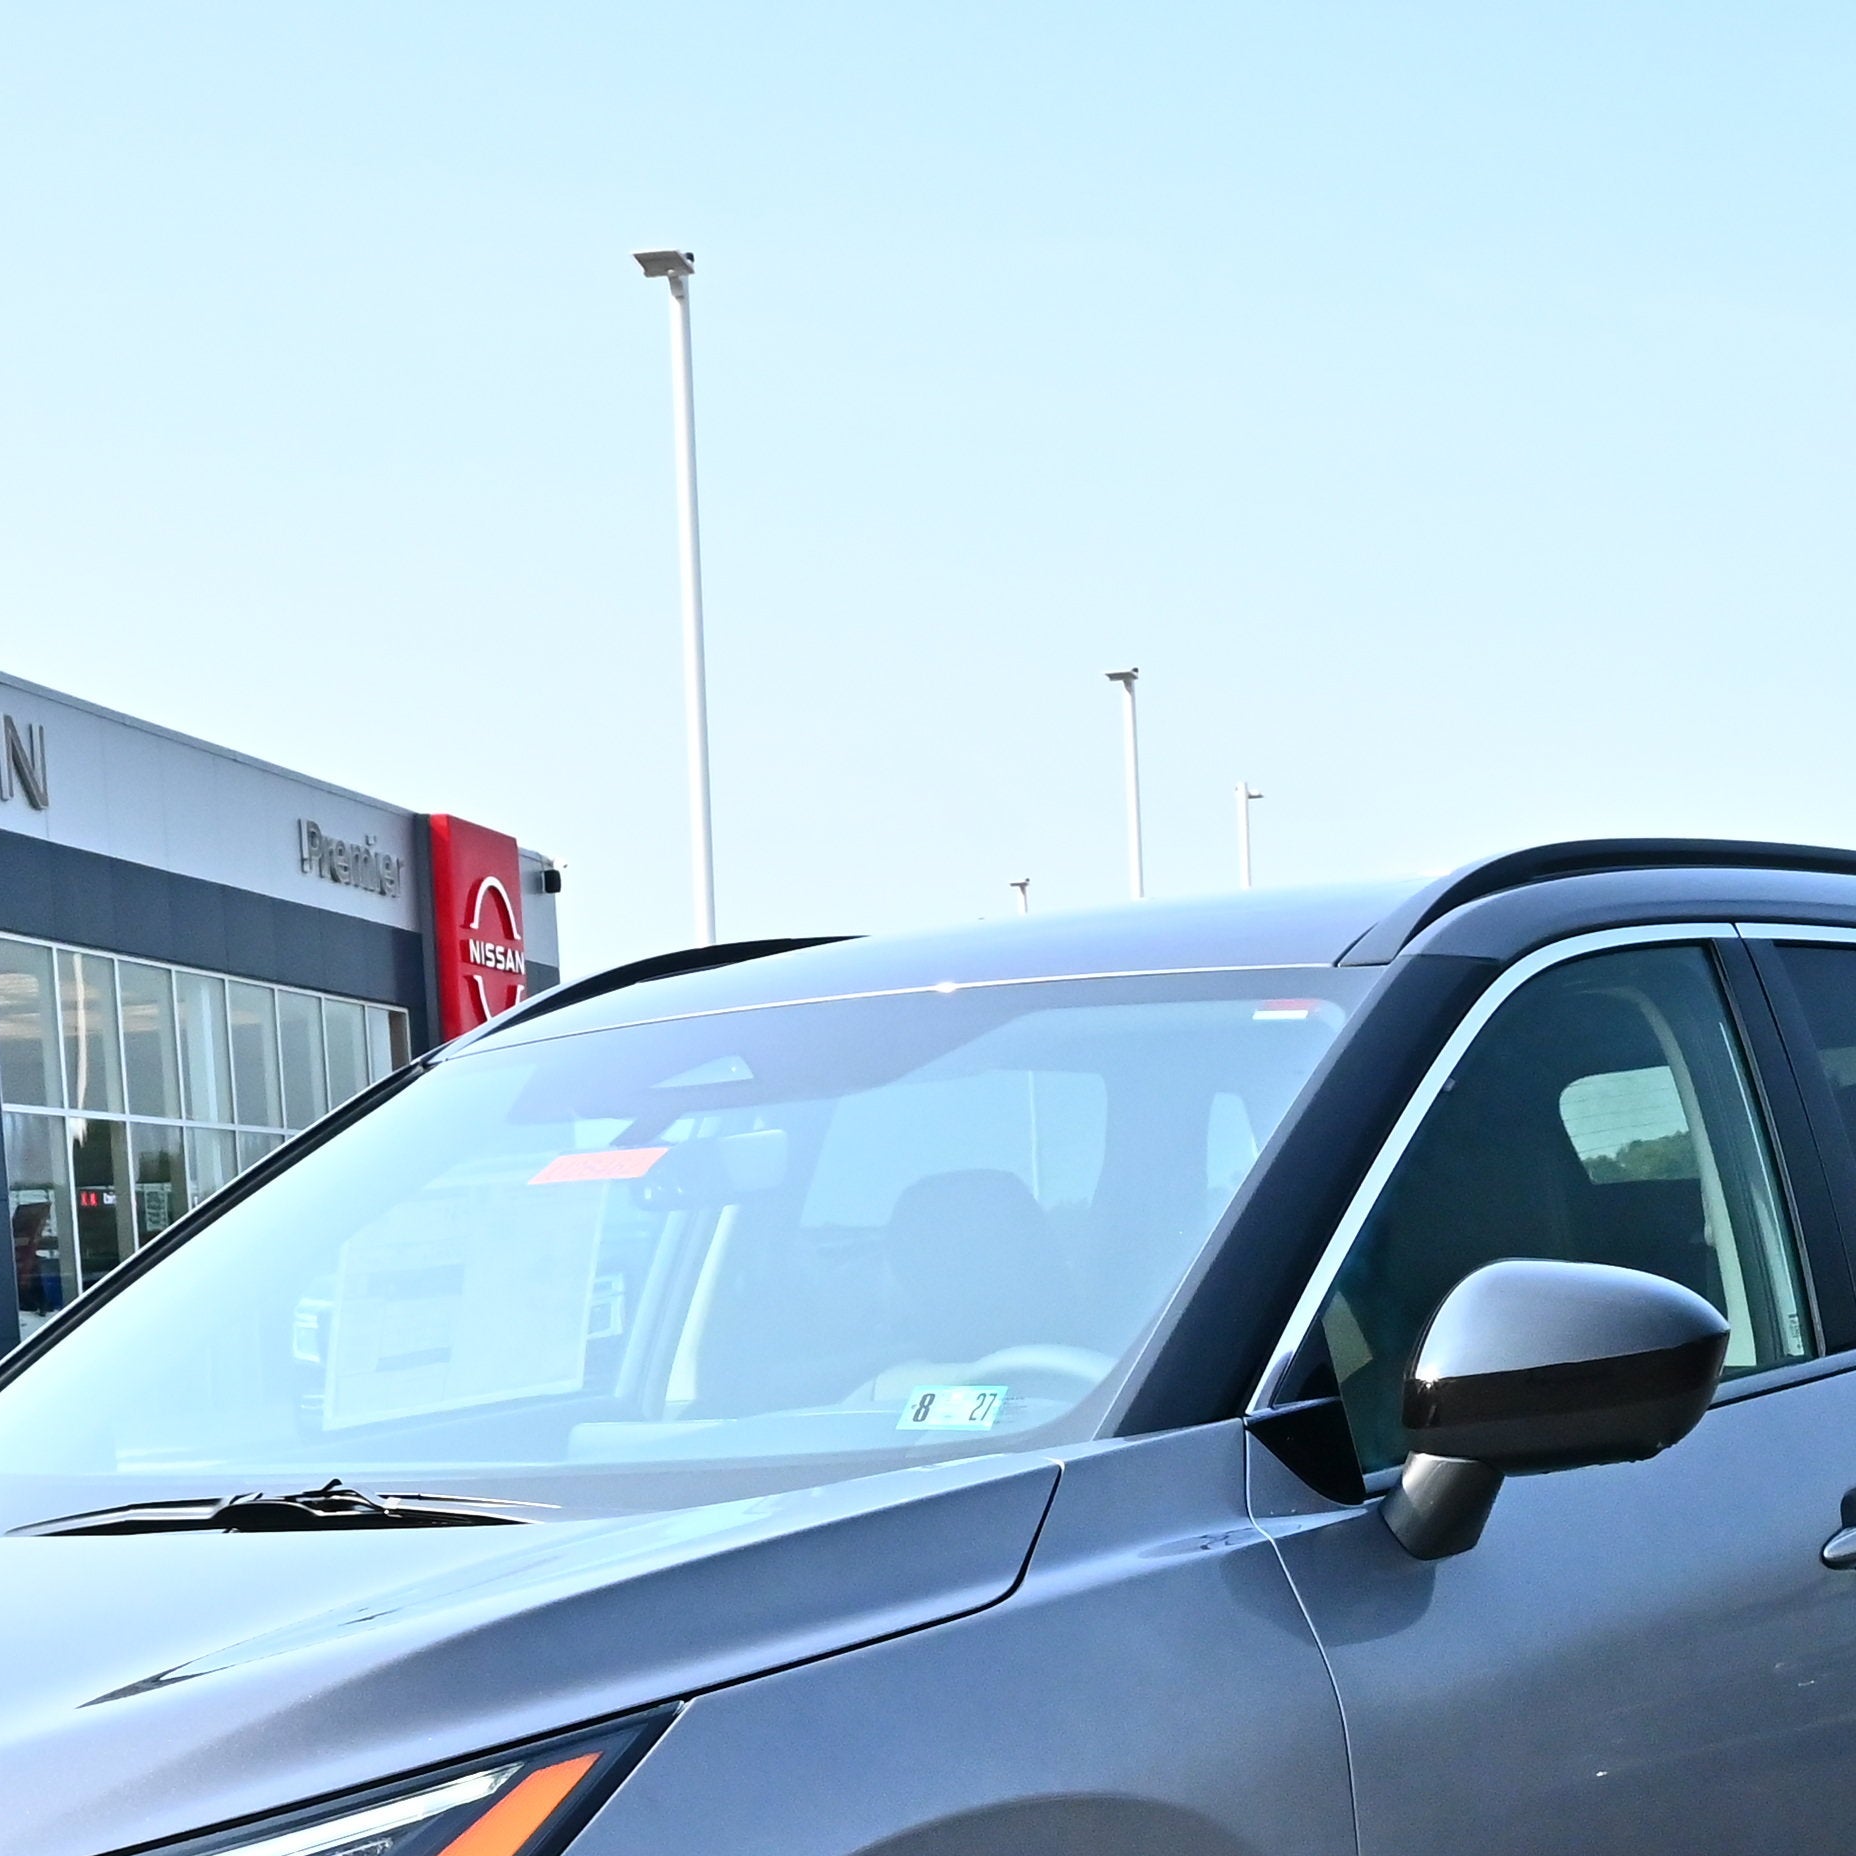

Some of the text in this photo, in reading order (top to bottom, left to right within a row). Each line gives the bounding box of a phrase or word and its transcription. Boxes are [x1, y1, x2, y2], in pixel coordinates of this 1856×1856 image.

[298, 818, 405, 898] Premier
[467, 938, 526, 975] NISSAN
[912, 1393, 936, 1422] 8
[968, 1392, 998, 1421] 27
